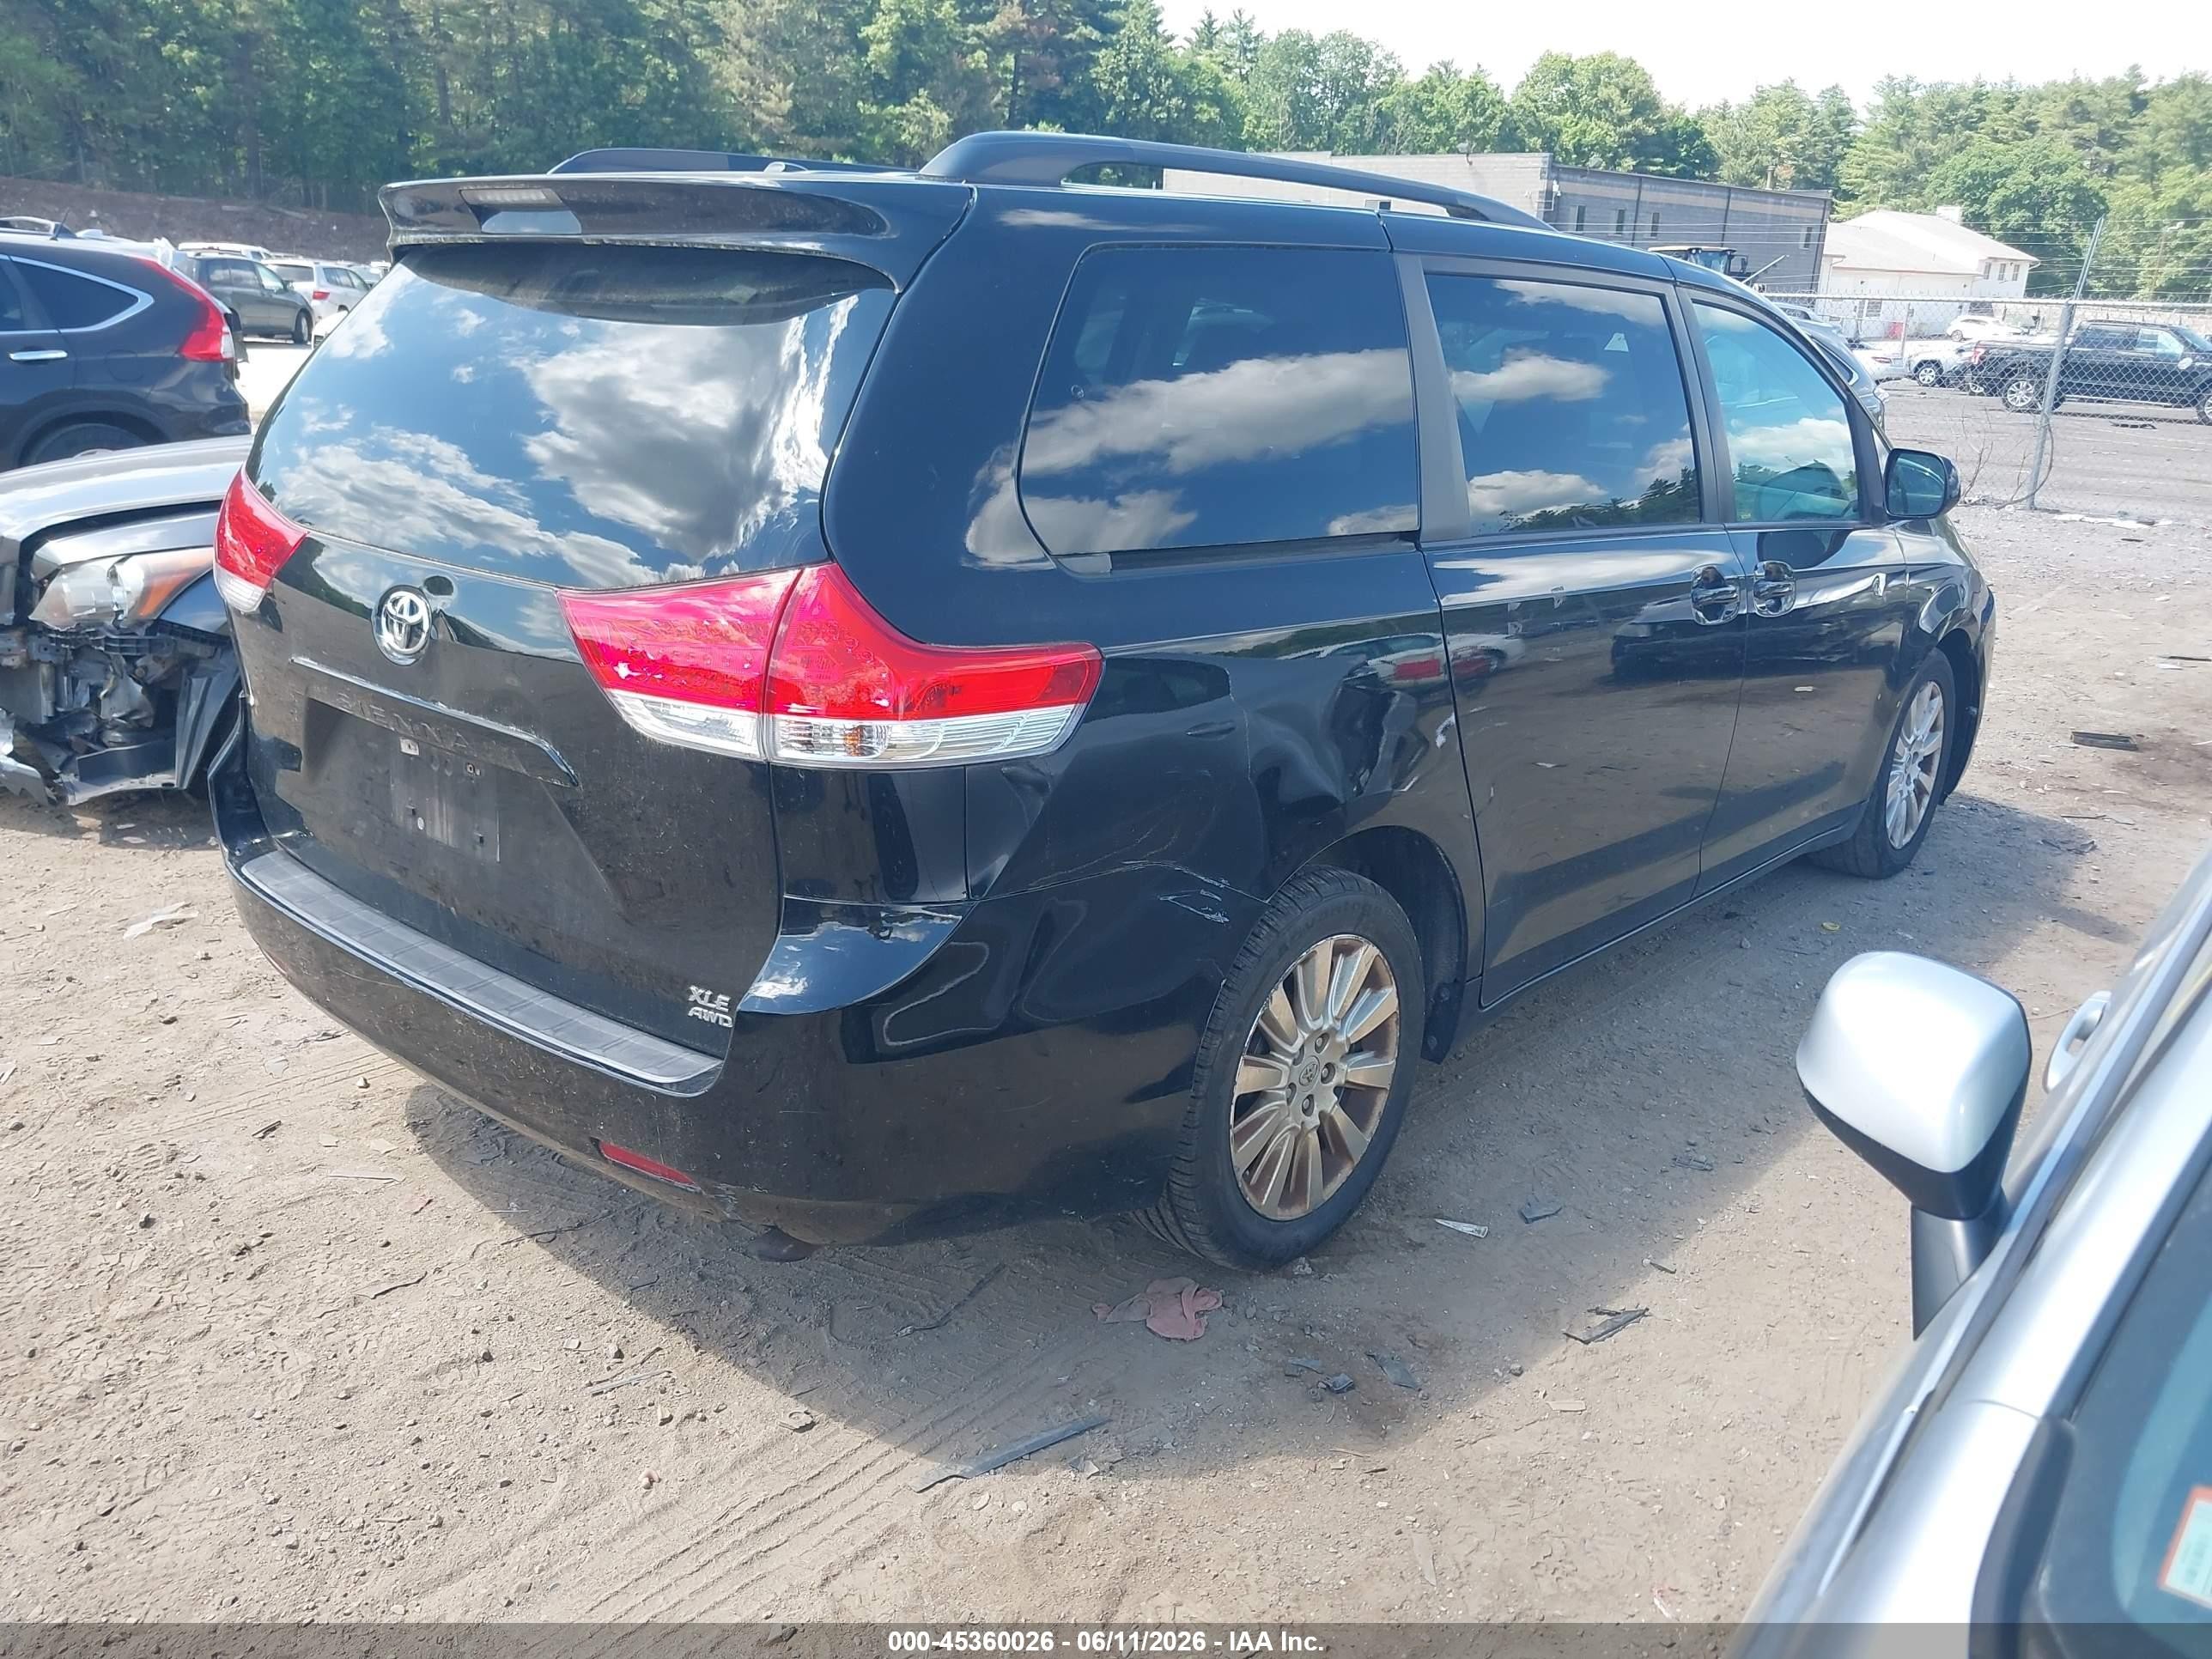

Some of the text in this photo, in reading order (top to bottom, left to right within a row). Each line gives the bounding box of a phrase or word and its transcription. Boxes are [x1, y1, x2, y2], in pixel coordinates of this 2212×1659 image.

[336, 689, 470, 750] SIENNA
[688, 985, 731, 1013] XLE
[688, 1006, 733, 1028] AWD
